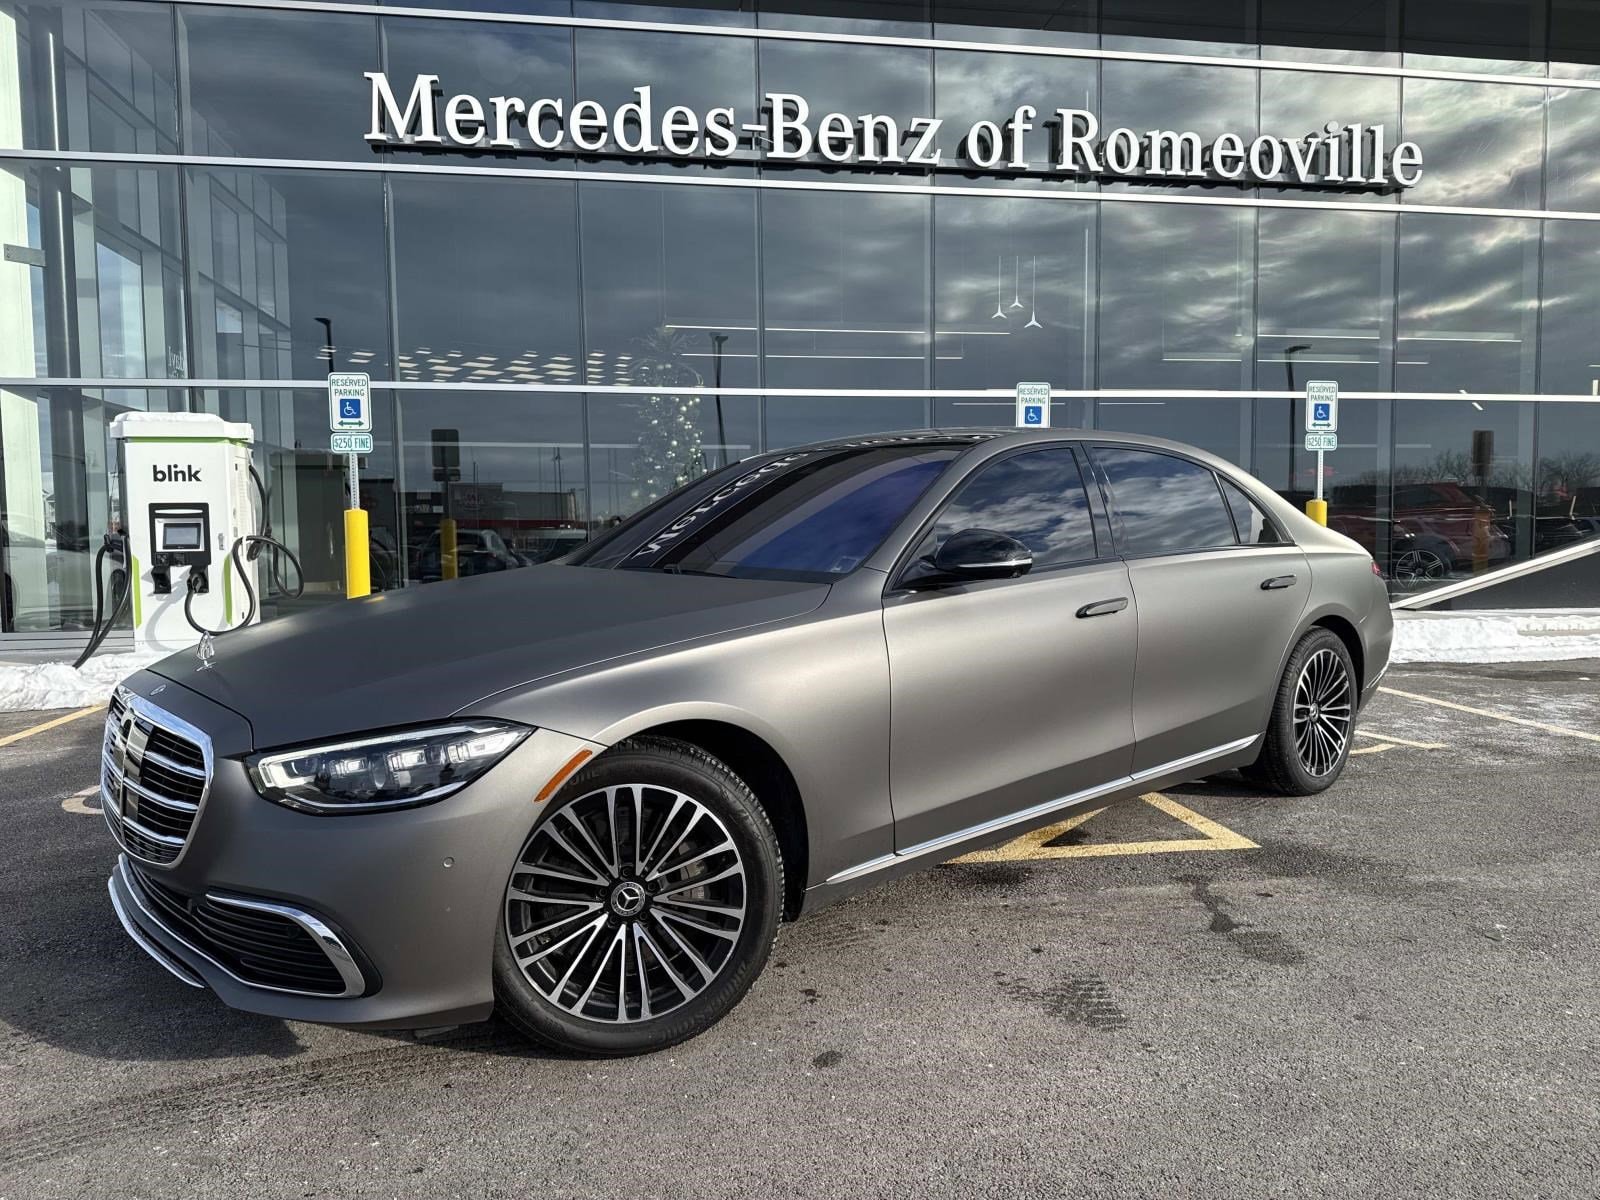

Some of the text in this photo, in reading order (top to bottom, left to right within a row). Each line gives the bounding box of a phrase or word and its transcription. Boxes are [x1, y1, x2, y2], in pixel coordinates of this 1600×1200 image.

[363, 71, 1424, 186] Mercedes-Benz of Romeoville
[331, 378, 367, 387] RESERVED
[334, 388, 365, 397] PARKING
[1019, 387, 1048, 395] RESERVED
[1020, 397, 1046, 405] PARKING
[1310, 394, 1334, 402] PARKING
[334, 437, 370, 449] $250 FINE
[1322, 436, 1336, 447] FINE
[152, 464, 202, 483] blink
